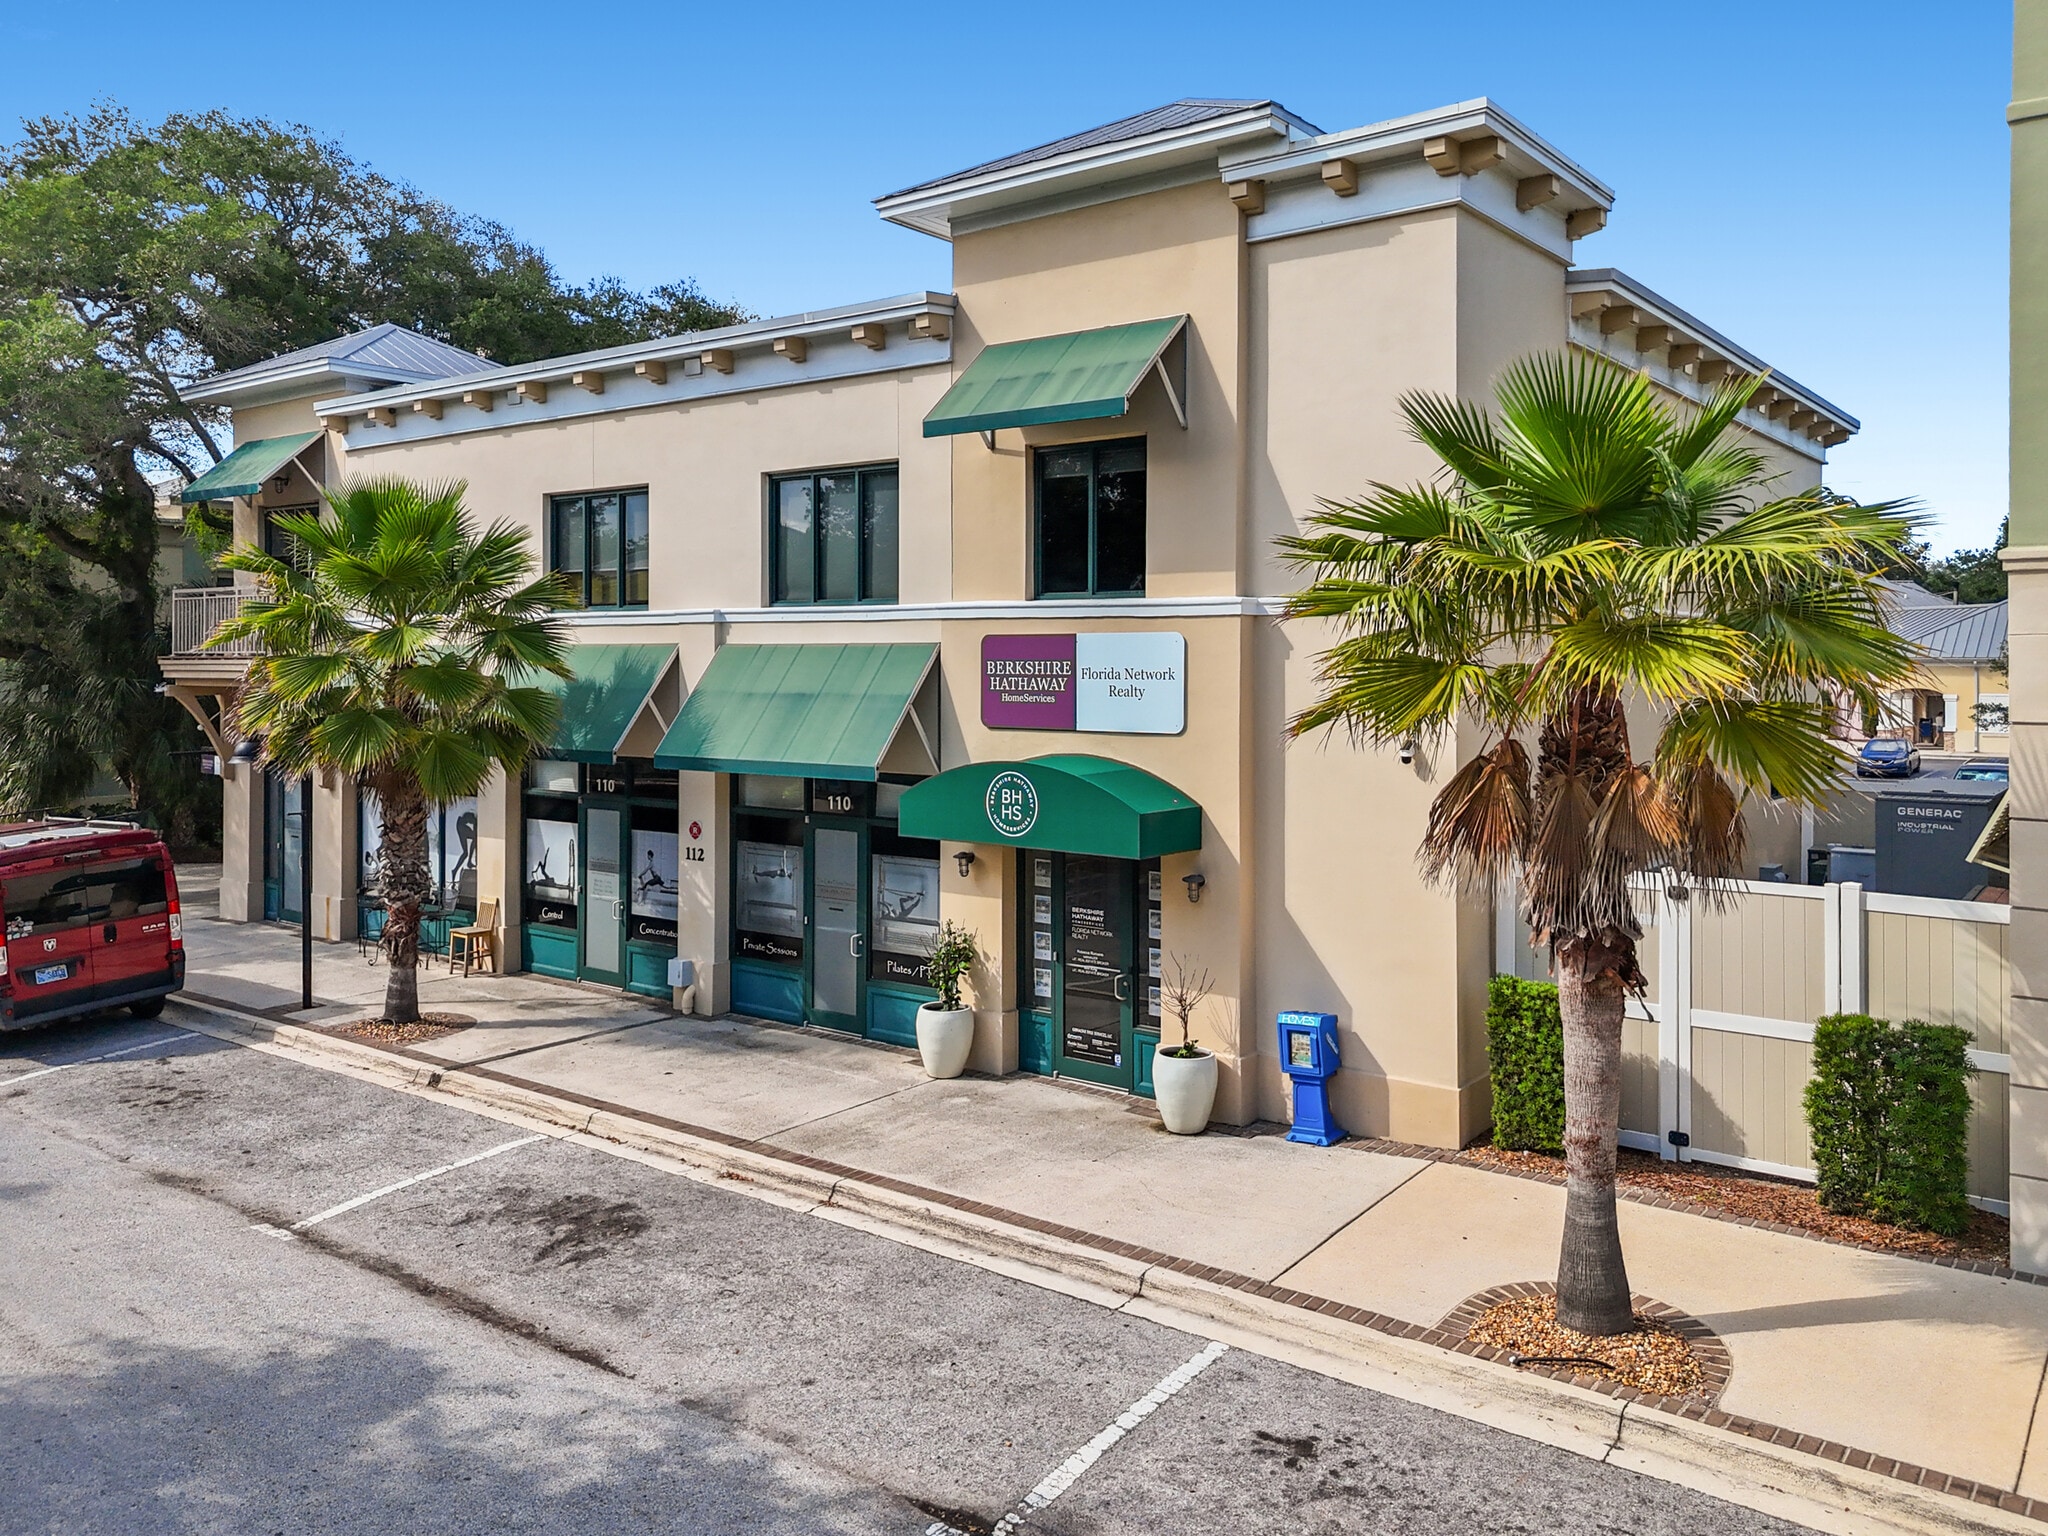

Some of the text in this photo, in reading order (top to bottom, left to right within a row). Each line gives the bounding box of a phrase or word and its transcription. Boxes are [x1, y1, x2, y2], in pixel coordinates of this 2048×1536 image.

[986, 661, 1072, 675] BERKSHIRE
[1081, 667, 1175, 680] Florida Network
[990, 677, 1068, 691] HATHAWAY
[1001, 693, 1056, 703] HomeServices
[1109, 684, 1145, 700] Realty
[596, 778, 615, 792] 110
[827, 795, 851, 811] 110
[1001, 788, 1022, 805] BH
[1001, 804, 1022, 821] HS
[1897, 806, 1962, 818] GENERAC
[1897, 821, 1954, 831] INDUSTRIAL
[685, 846, 705, 862] 112
[541, 906, 564, 920] Control
[1071, 906, 1104, 916] BERKSHIRE
[1071, 912, 1104, 922] HATHAWAY
[743, 937, 798, 957] Private Sessions
